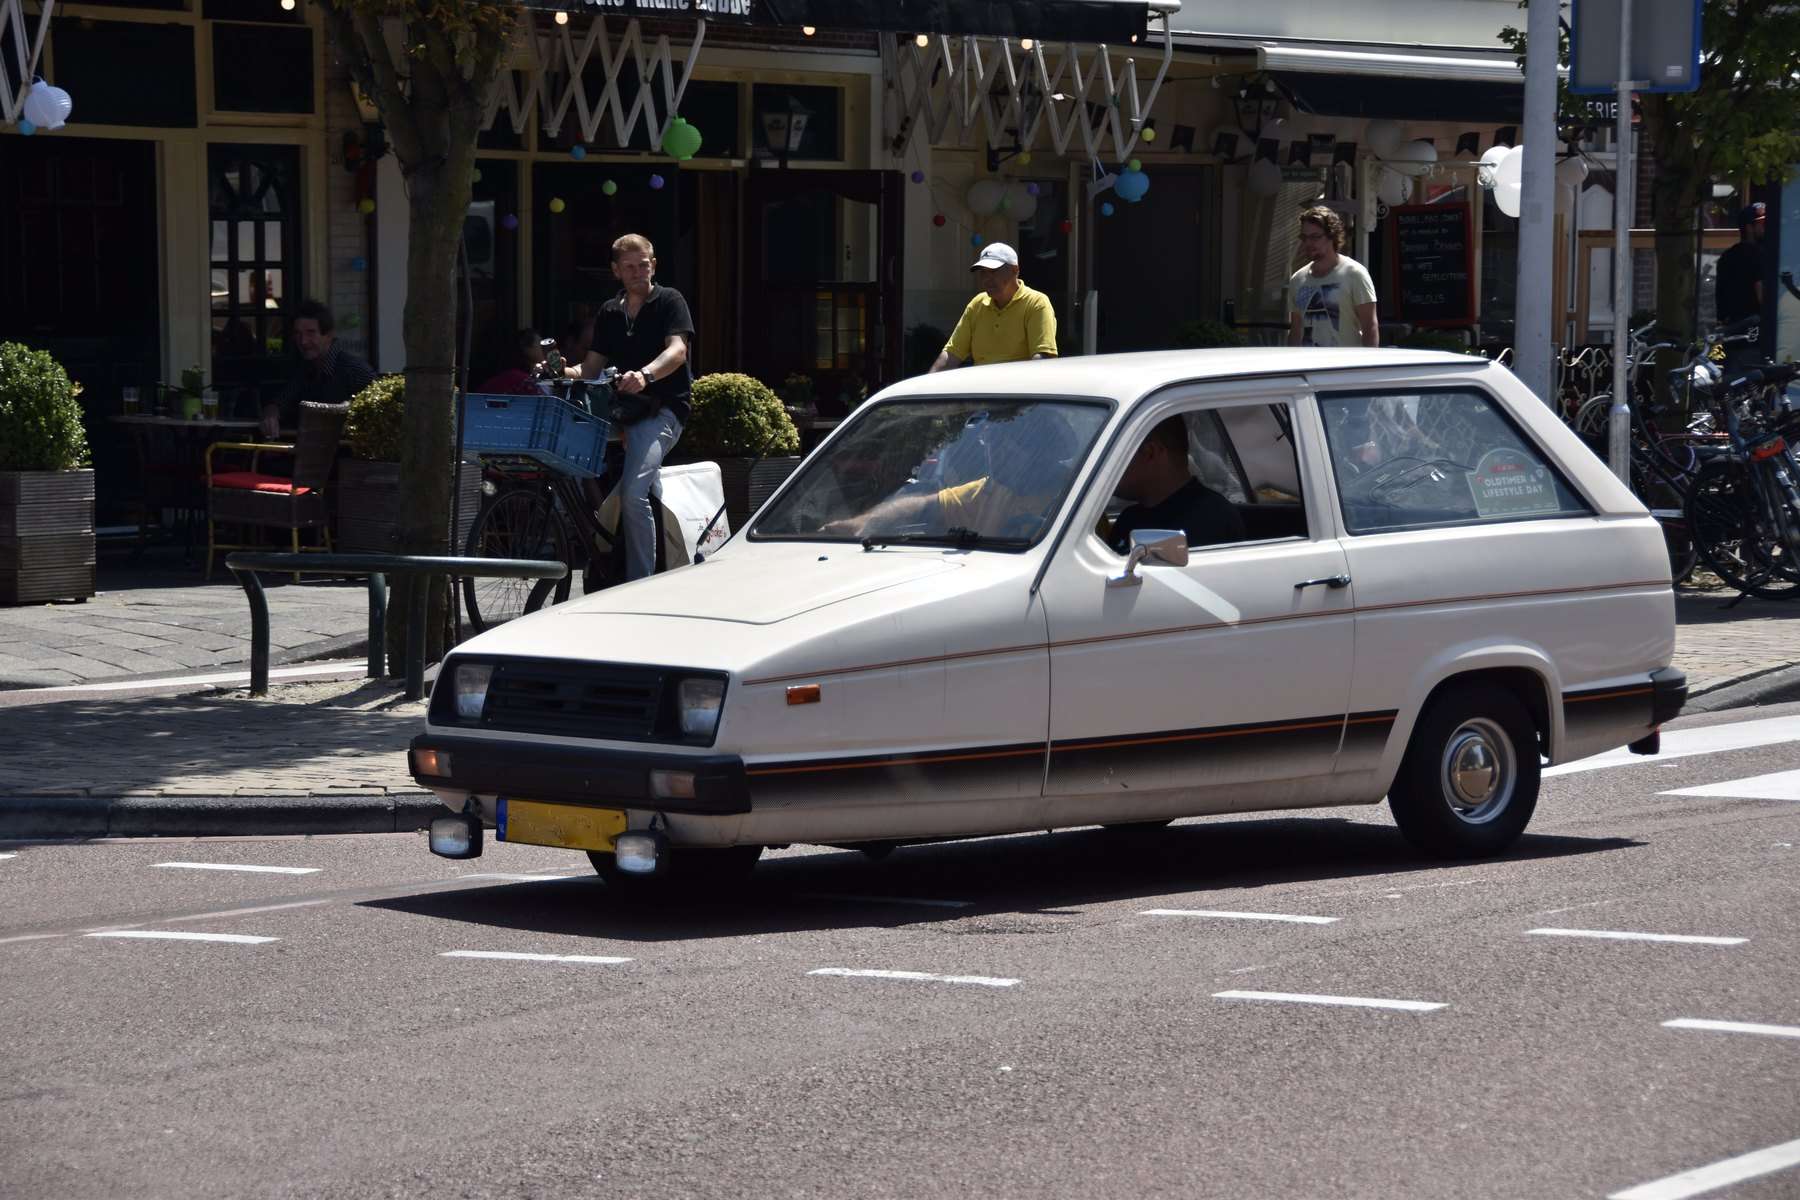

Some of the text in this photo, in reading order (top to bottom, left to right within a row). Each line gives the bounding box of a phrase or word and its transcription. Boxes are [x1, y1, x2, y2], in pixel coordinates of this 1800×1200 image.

[1484, 475, 1527, 487] OLDTIMER
[1482, 484, 1544, 497] LIFESTYLE DAY
